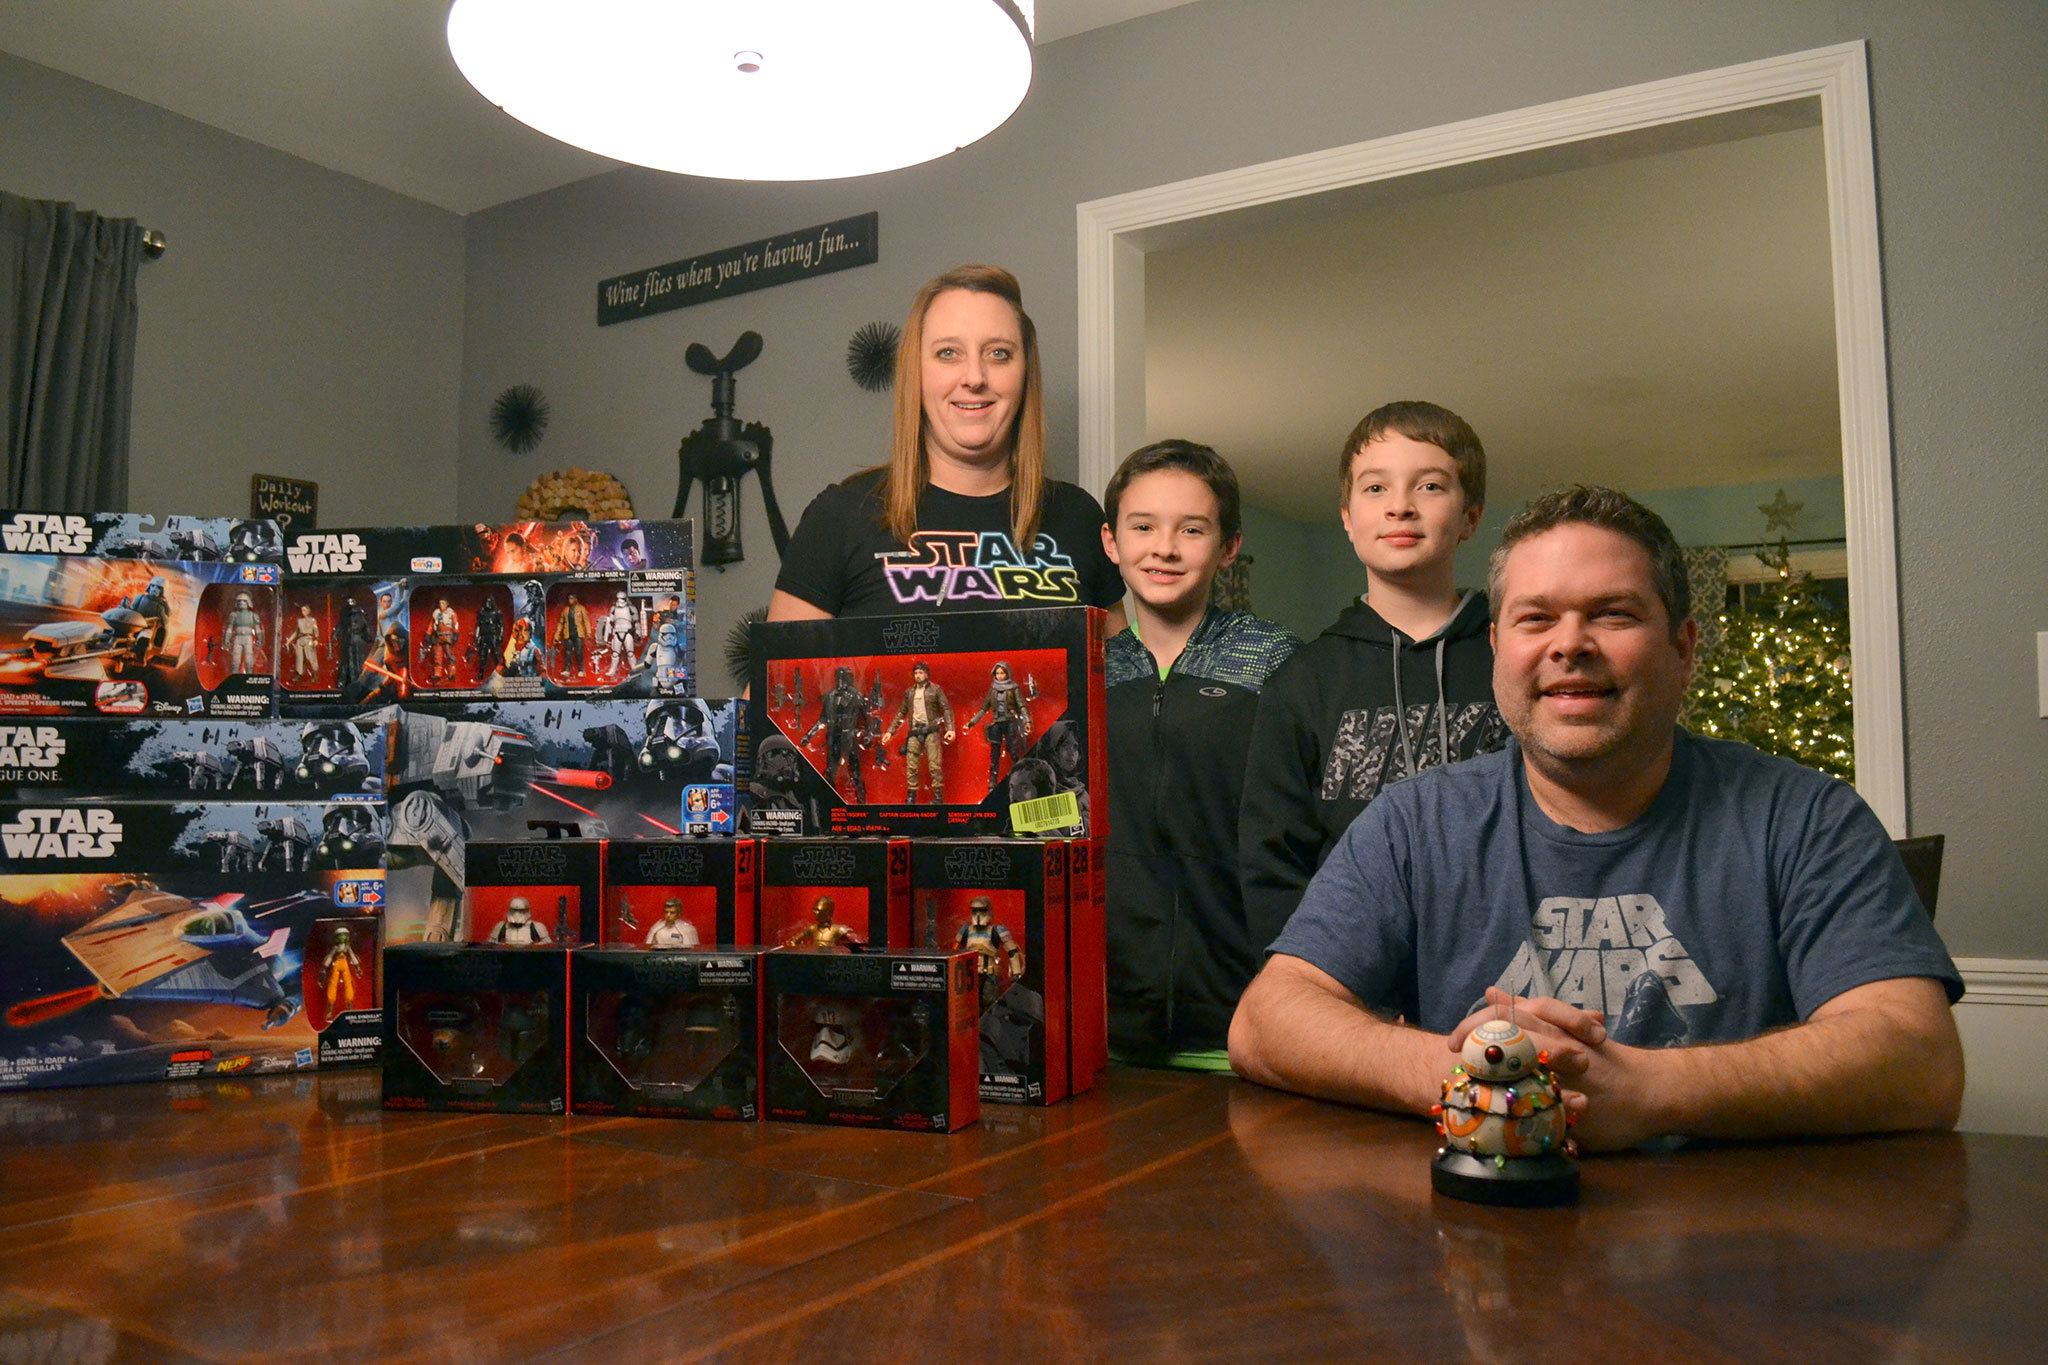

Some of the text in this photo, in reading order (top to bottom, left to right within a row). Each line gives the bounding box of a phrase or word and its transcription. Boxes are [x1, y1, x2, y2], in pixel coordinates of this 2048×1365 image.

[605, 279, 639, 307] Wine
[640, 271, 672, 307] flies
[676, 261, 712, 290] when
[714, 251, 759, 289] you're
[763, 240, 813, 269] having
[258, 479, 301, 499] Daily
[259, 493, 312, 514] Workout
[2, 514, 93, 534] STAR
[2, 533, 93, 553] WARS
[287, 534, 366, 554] STAR
[881, 531, 1074, 569] STAR
[287, 553, 366, 573] WARS
[644, 571, 682, 580] WARNING:
[883, 566, 1078, 603] WARS
[883, 619, 939, 635] STAR
[883, 633, 939, 648] WARS
[153, 701, 182, 714] Disney
[227, 694, 270, 704] WARNING:
[0, 726, 66, 747] TAR
[0, 747, 66, 767] ARS
[0, 770, 24, 781] GUE
[2, 809, 122, 834] STAR
[765, 811, 801, 820] WARNING:
[2, 833, 122, 858] WARS
[498, 845, 568, 862] STAR
[638, 845, 704, 862] STAR
[792, 846, 855, 863] STAR
[945, 847, 1011, 864] STAR
[498, 861, 568, 877] WARS
[639, 861, 704, 877] WARS
[792, 862, 855, 878] WARS
[945, 863, 1010, 880] WARS
[1533, 893, 1673, 950] STAR
[1470, 937, 1717, 1016] WARS
[337, 1036, 382, 1048] WARNING:
[16, 1058, 36, 1066] EDAD
[216, 1056, 252, 1072] NERF
